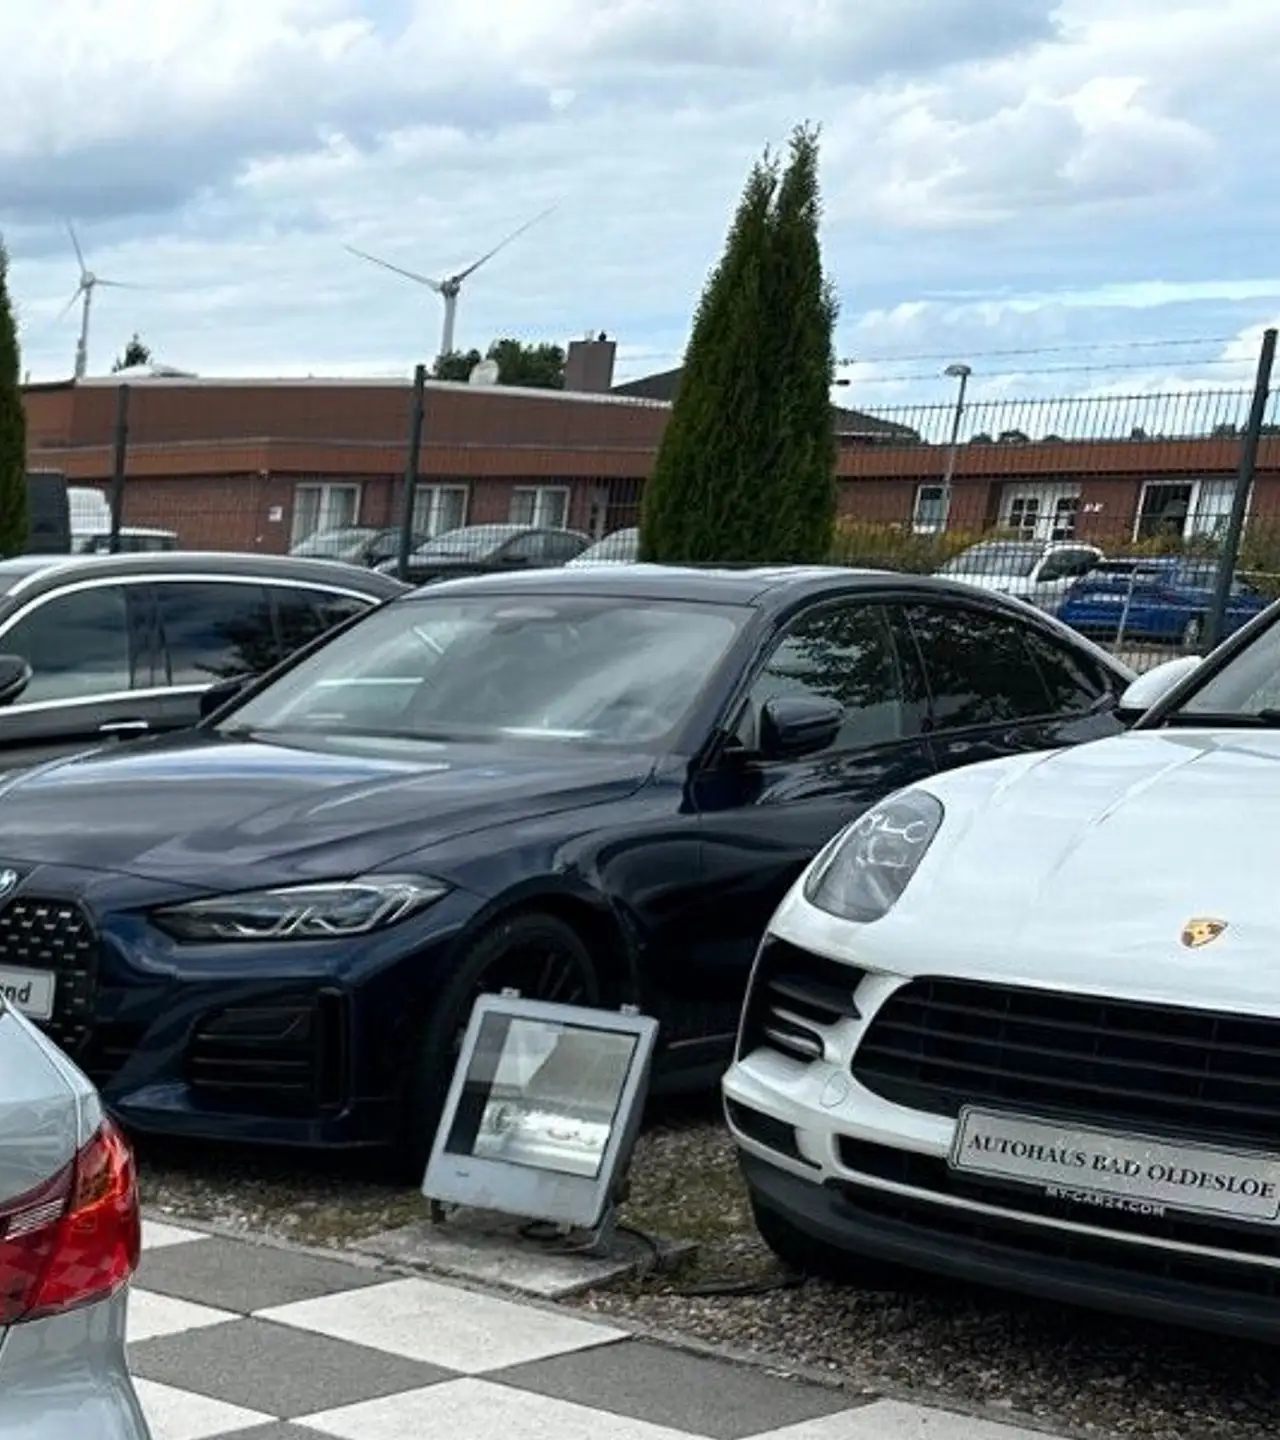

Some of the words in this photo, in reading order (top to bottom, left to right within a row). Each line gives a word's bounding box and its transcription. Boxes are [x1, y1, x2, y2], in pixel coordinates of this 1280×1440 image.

[968, 1134, 1086, 1168] AUTOHAUS
[1092, 1154, 1141, 1177] BAD
[1147, 1164, 1276, 1199] OLDESLOE
